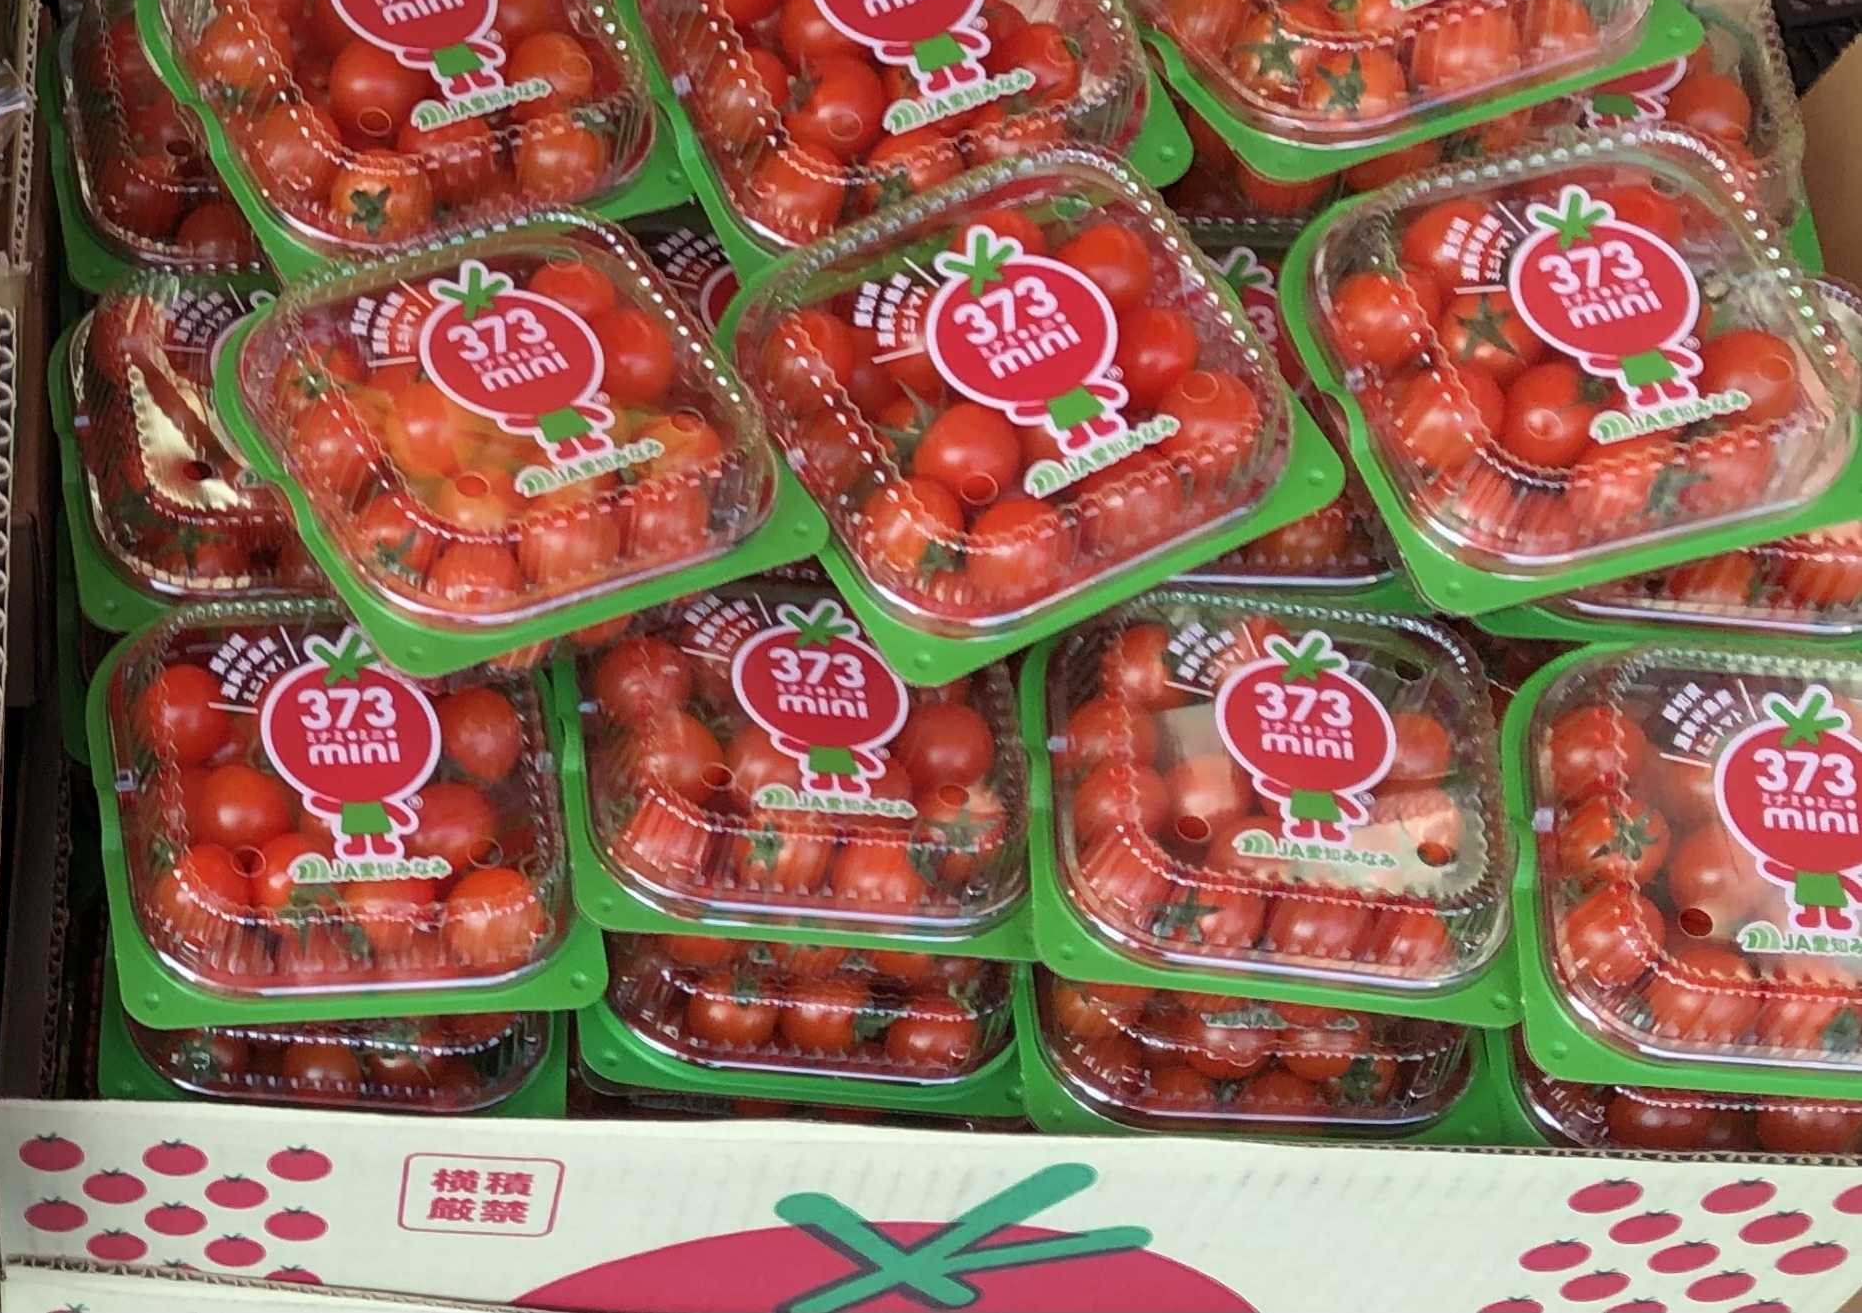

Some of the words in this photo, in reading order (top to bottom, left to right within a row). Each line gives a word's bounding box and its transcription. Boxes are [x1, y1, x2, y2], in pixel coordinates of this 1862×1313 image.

[1538, 239, 1644, 295] 373
[952, 276, 1059, 342] 373
[1568, 278, 1663, 329] mini
[447, 307, 548, 362] 373
[988, 311, 1082, 379] mini
[481, 341, 570, 393] mini
[769, 646, 866, 688] 373
[297, 686, 397, 730] 373
[777, 683, 869, 720] mini
[1254, 682, 1354, 728] 373
[308, 728, 401, 766] mini
[1261, 723, 1354, 761] mini
[1753, 748, 1857, 797] 373
[1763, 796, 1859, 836] mini
[431, 1168, 534, 1196] 横積
[426, 1197, 530, 1224] 厳禁
